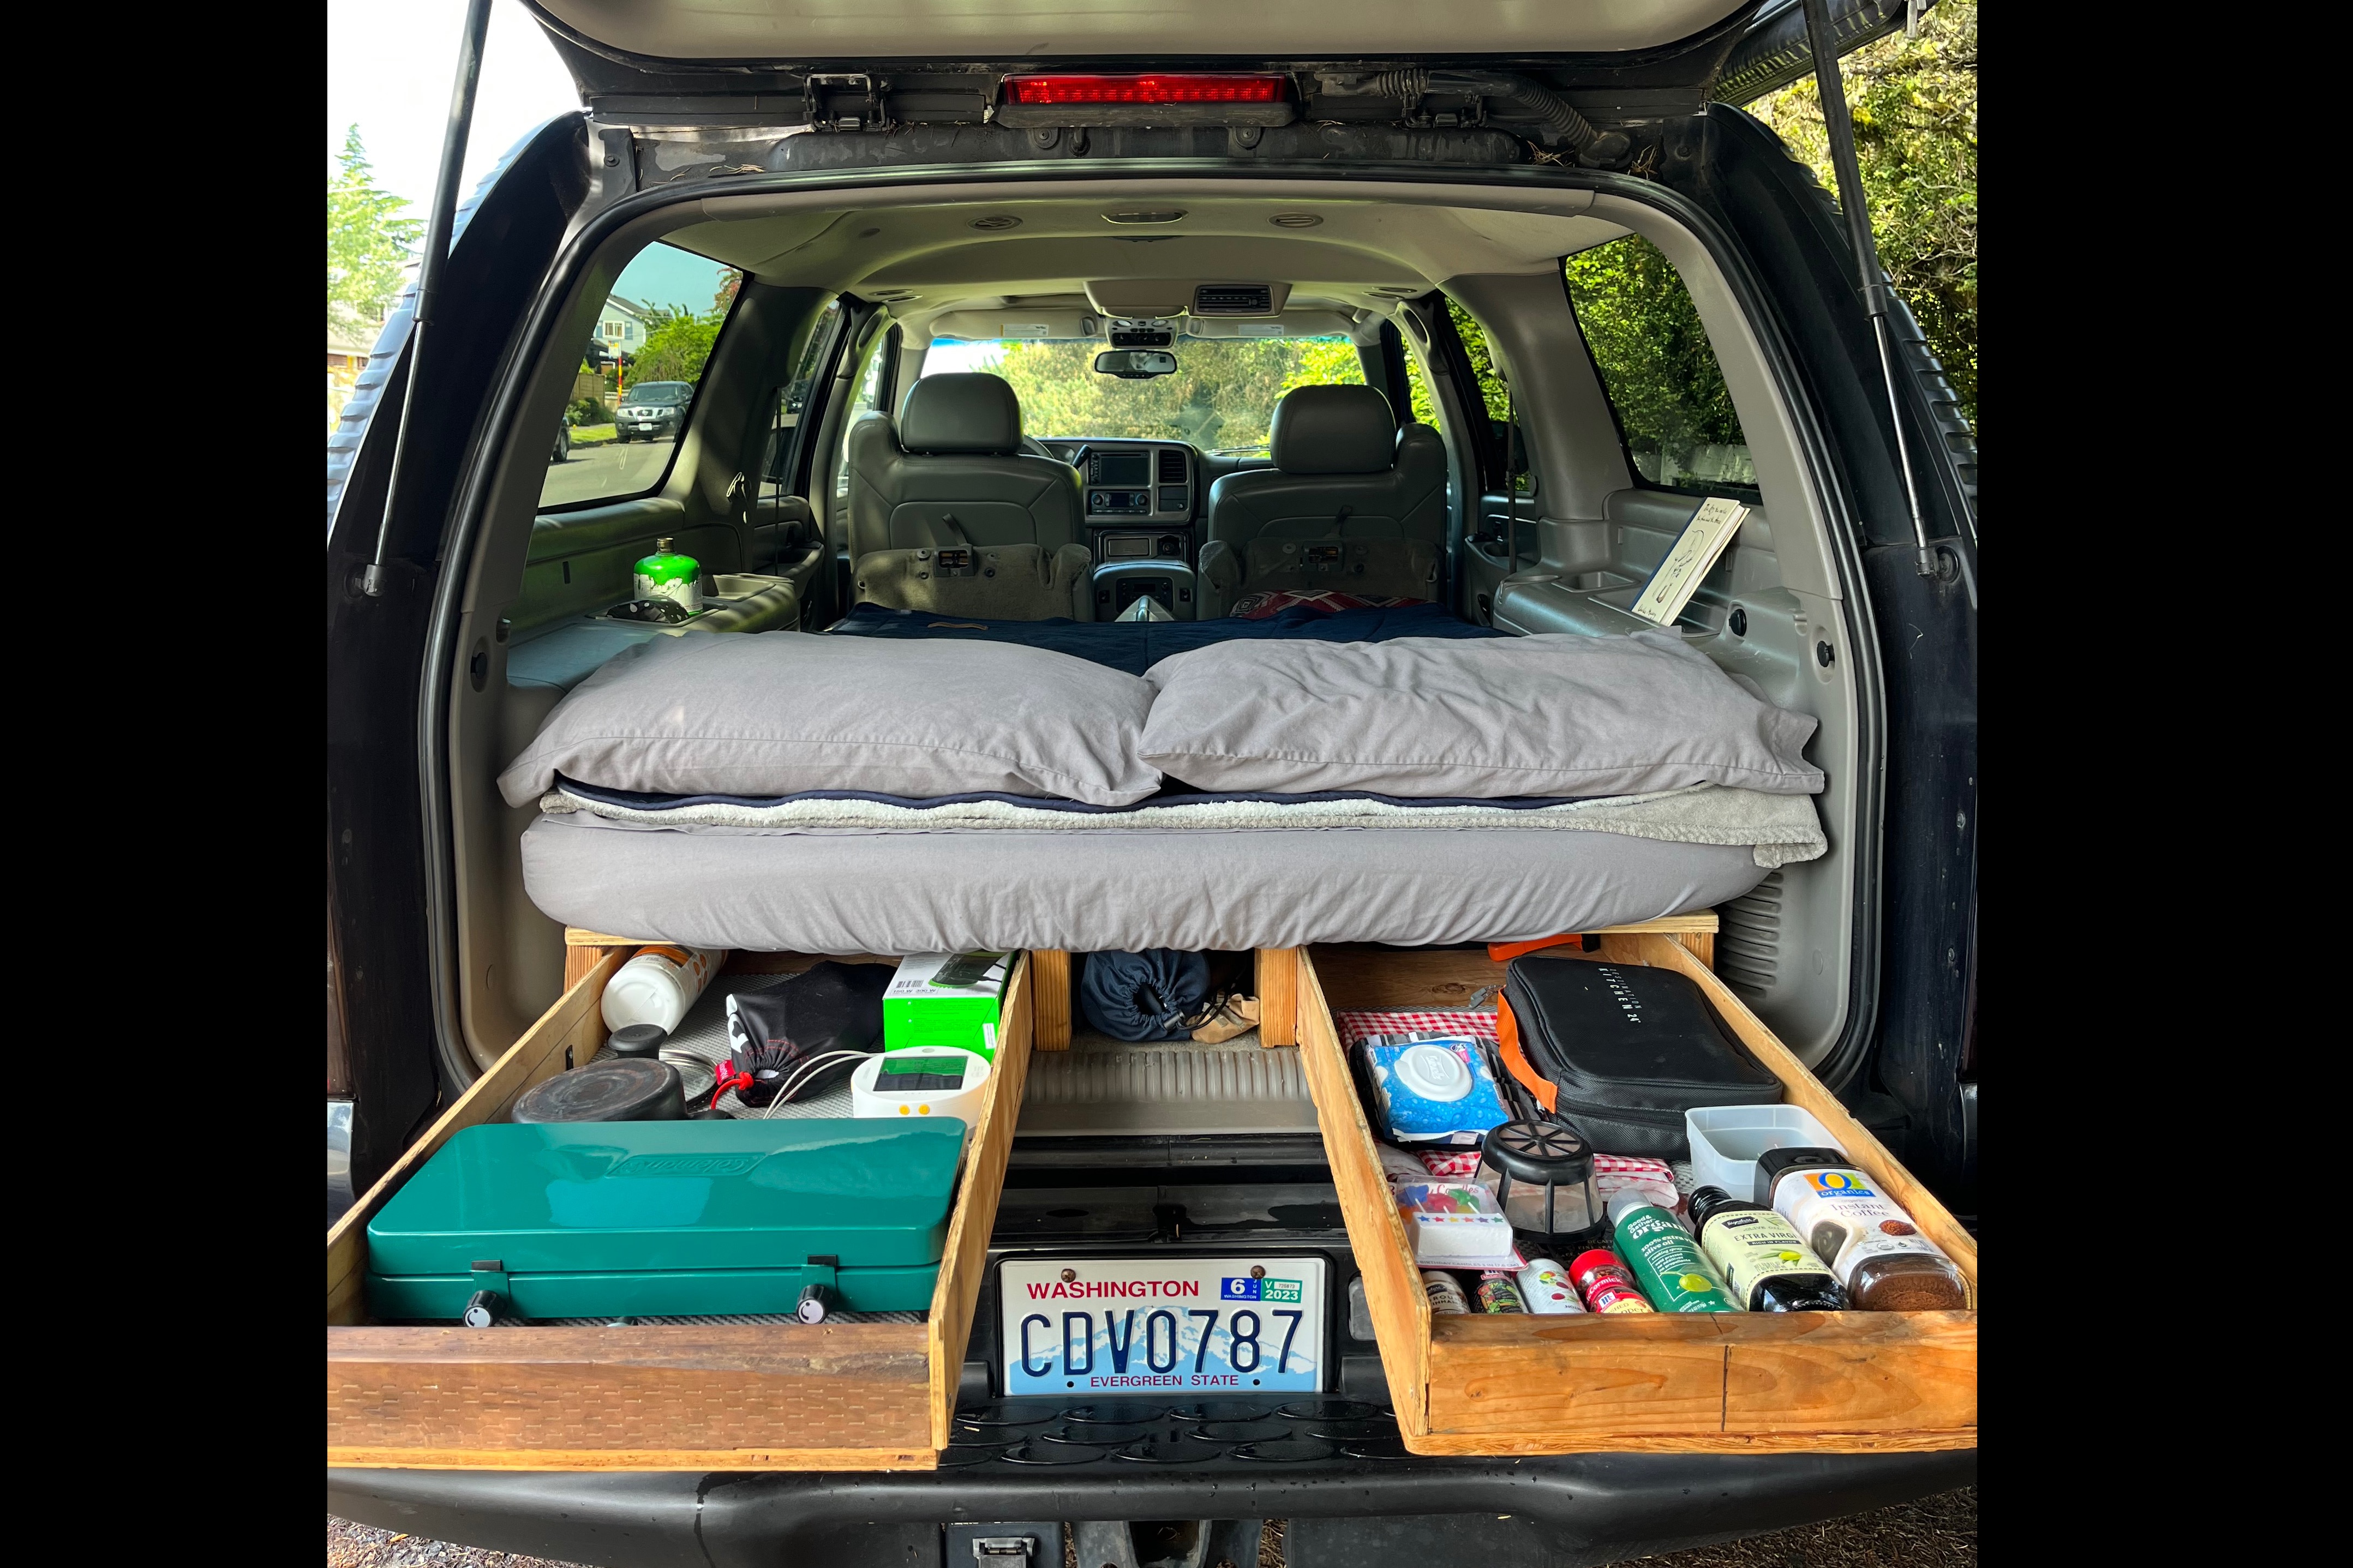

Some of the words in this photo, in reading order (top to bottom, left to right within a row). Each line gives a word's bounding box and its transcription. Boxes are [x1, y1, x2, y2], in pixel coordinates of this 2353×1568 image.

[1598, 968, 1633, 1009] KITCHEN
[1609, 968, 1642, 1009] DESTINATION
[1841, 1209, 1891, 1217] Coffee
[1734, 1233, 1769, 1241] EXTRA
[1641, 1237, 1661, 1252] 100%
[1644, 1243, 1662, 1257] olive
[1026, 1280, 1199, 1300] WASHINGTON
[1230, 1278, 1246, 1295] 6
[1265, 1281, 1273, 1289] V
[1265, 1289, 1298, 1300] 2023
[1021, 1309, 1303, 1377] CDV0787
[1090, 1375, 1182, 1387] EVERGREEN
[1191, 1374, 1239, 1386] STATE
